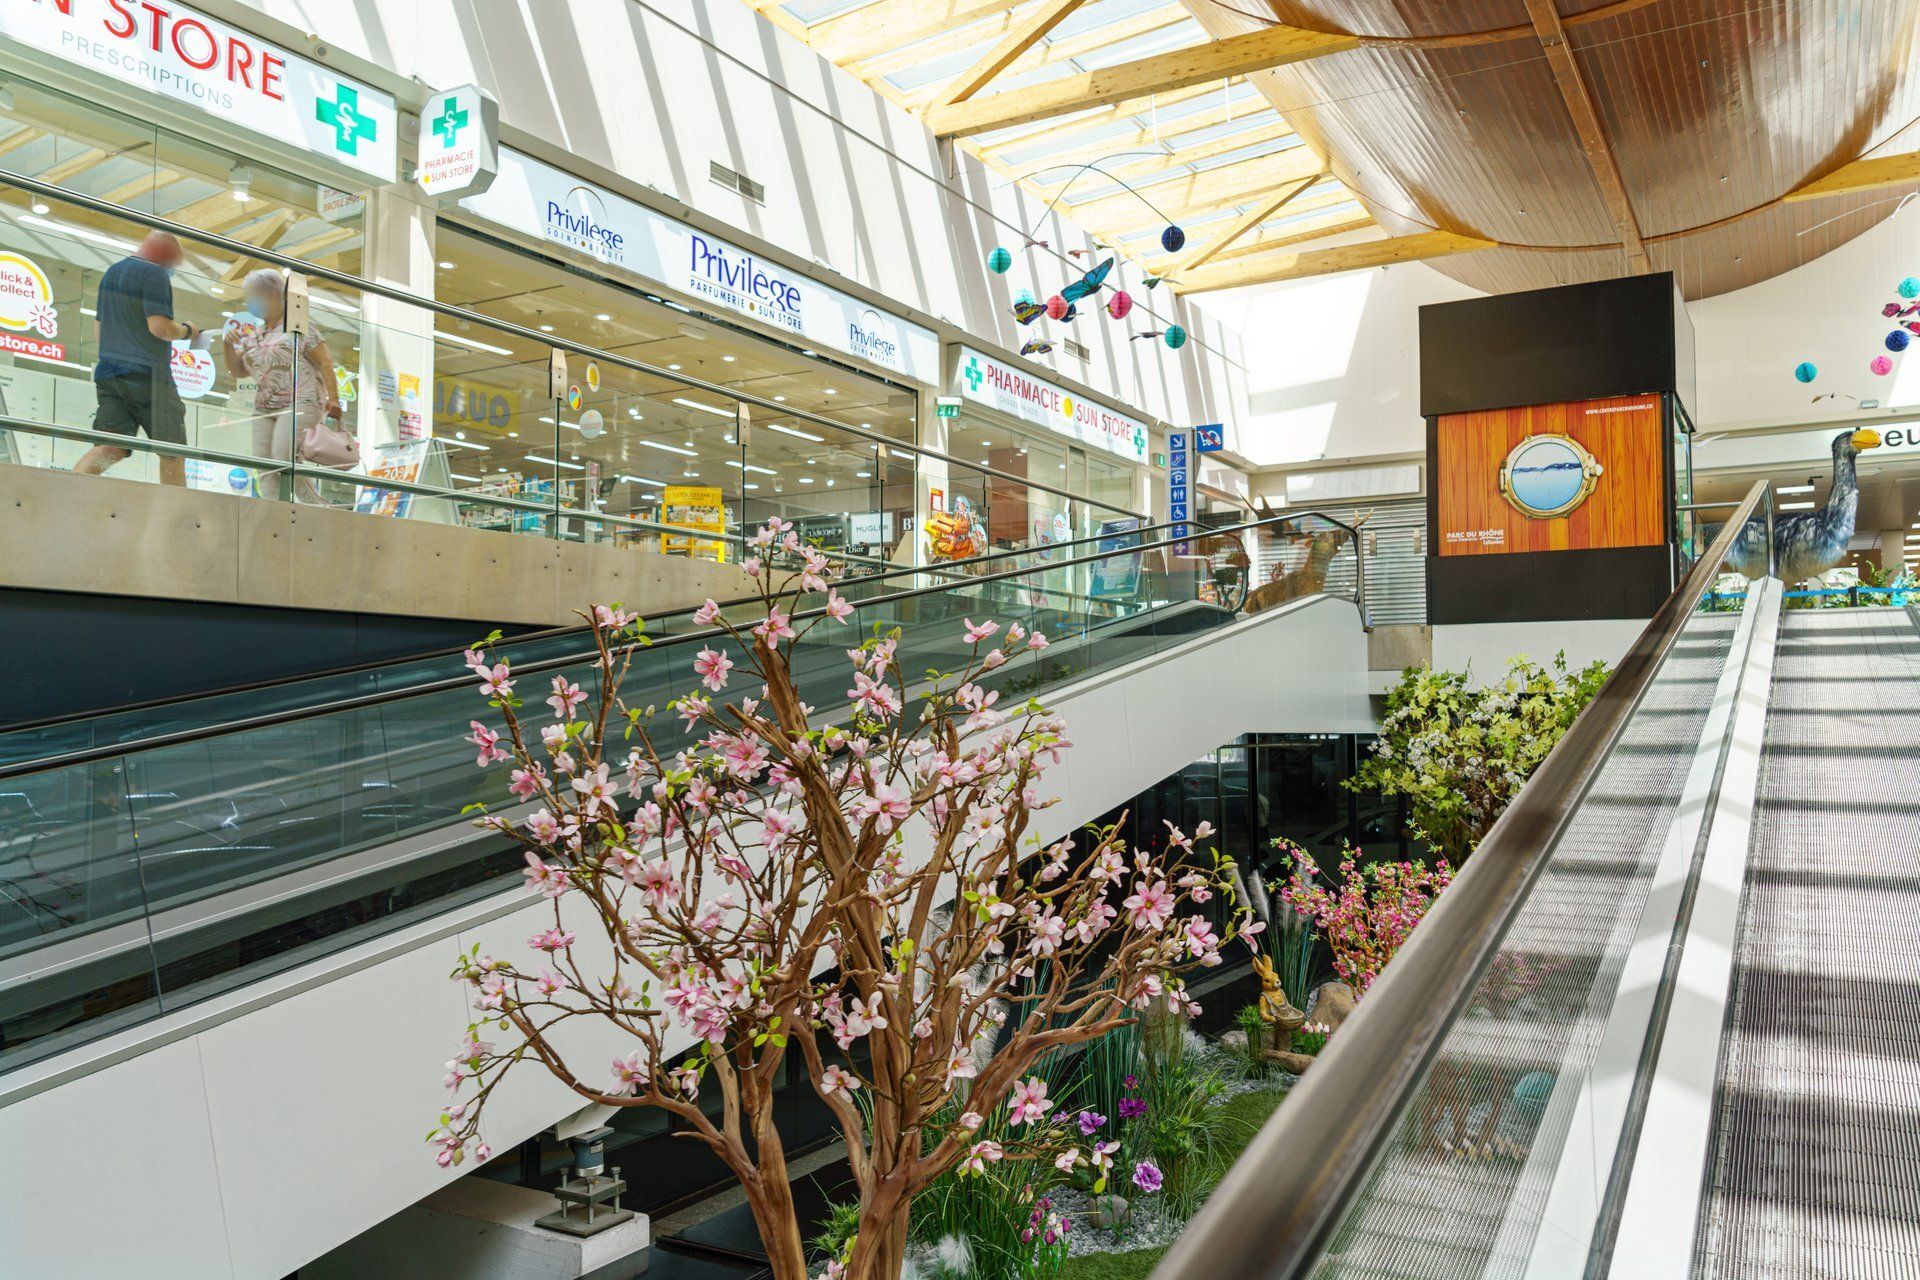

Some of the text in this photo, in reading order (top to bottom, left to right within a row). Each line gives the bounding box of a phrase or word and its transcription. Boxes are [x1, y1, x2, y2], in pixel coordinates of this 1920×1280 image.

[103, 0, 286, 101] STORE
[61, 29, 233, 109] PRESCRIPTIONS
[424, 149, 475, 170] PHARMACIE
[431, 164, 474, 183] SUN STORE
[547, 226, 578, 245] SOINS
[0, 270, 34, 287] lick &
[691, 234, 802, 313] Privilège
[0, 283, 36, 299] ollect
[690, 279, 803, 330] PARFUMERIE SUN STORE
[0, 335, 62, 359] store.ch
[987, 364, 1060, 412] PHARMACIE
[1076, 402, 1099, 428] SUN
[1101, 413, 1132, 441] STORE
[1876, 426, 1920, 448] eu
[1446, 531, 1466, 540] PARC
[1466, 531, 1478, 539] DU
[848, 543, 865, 555] Dior
